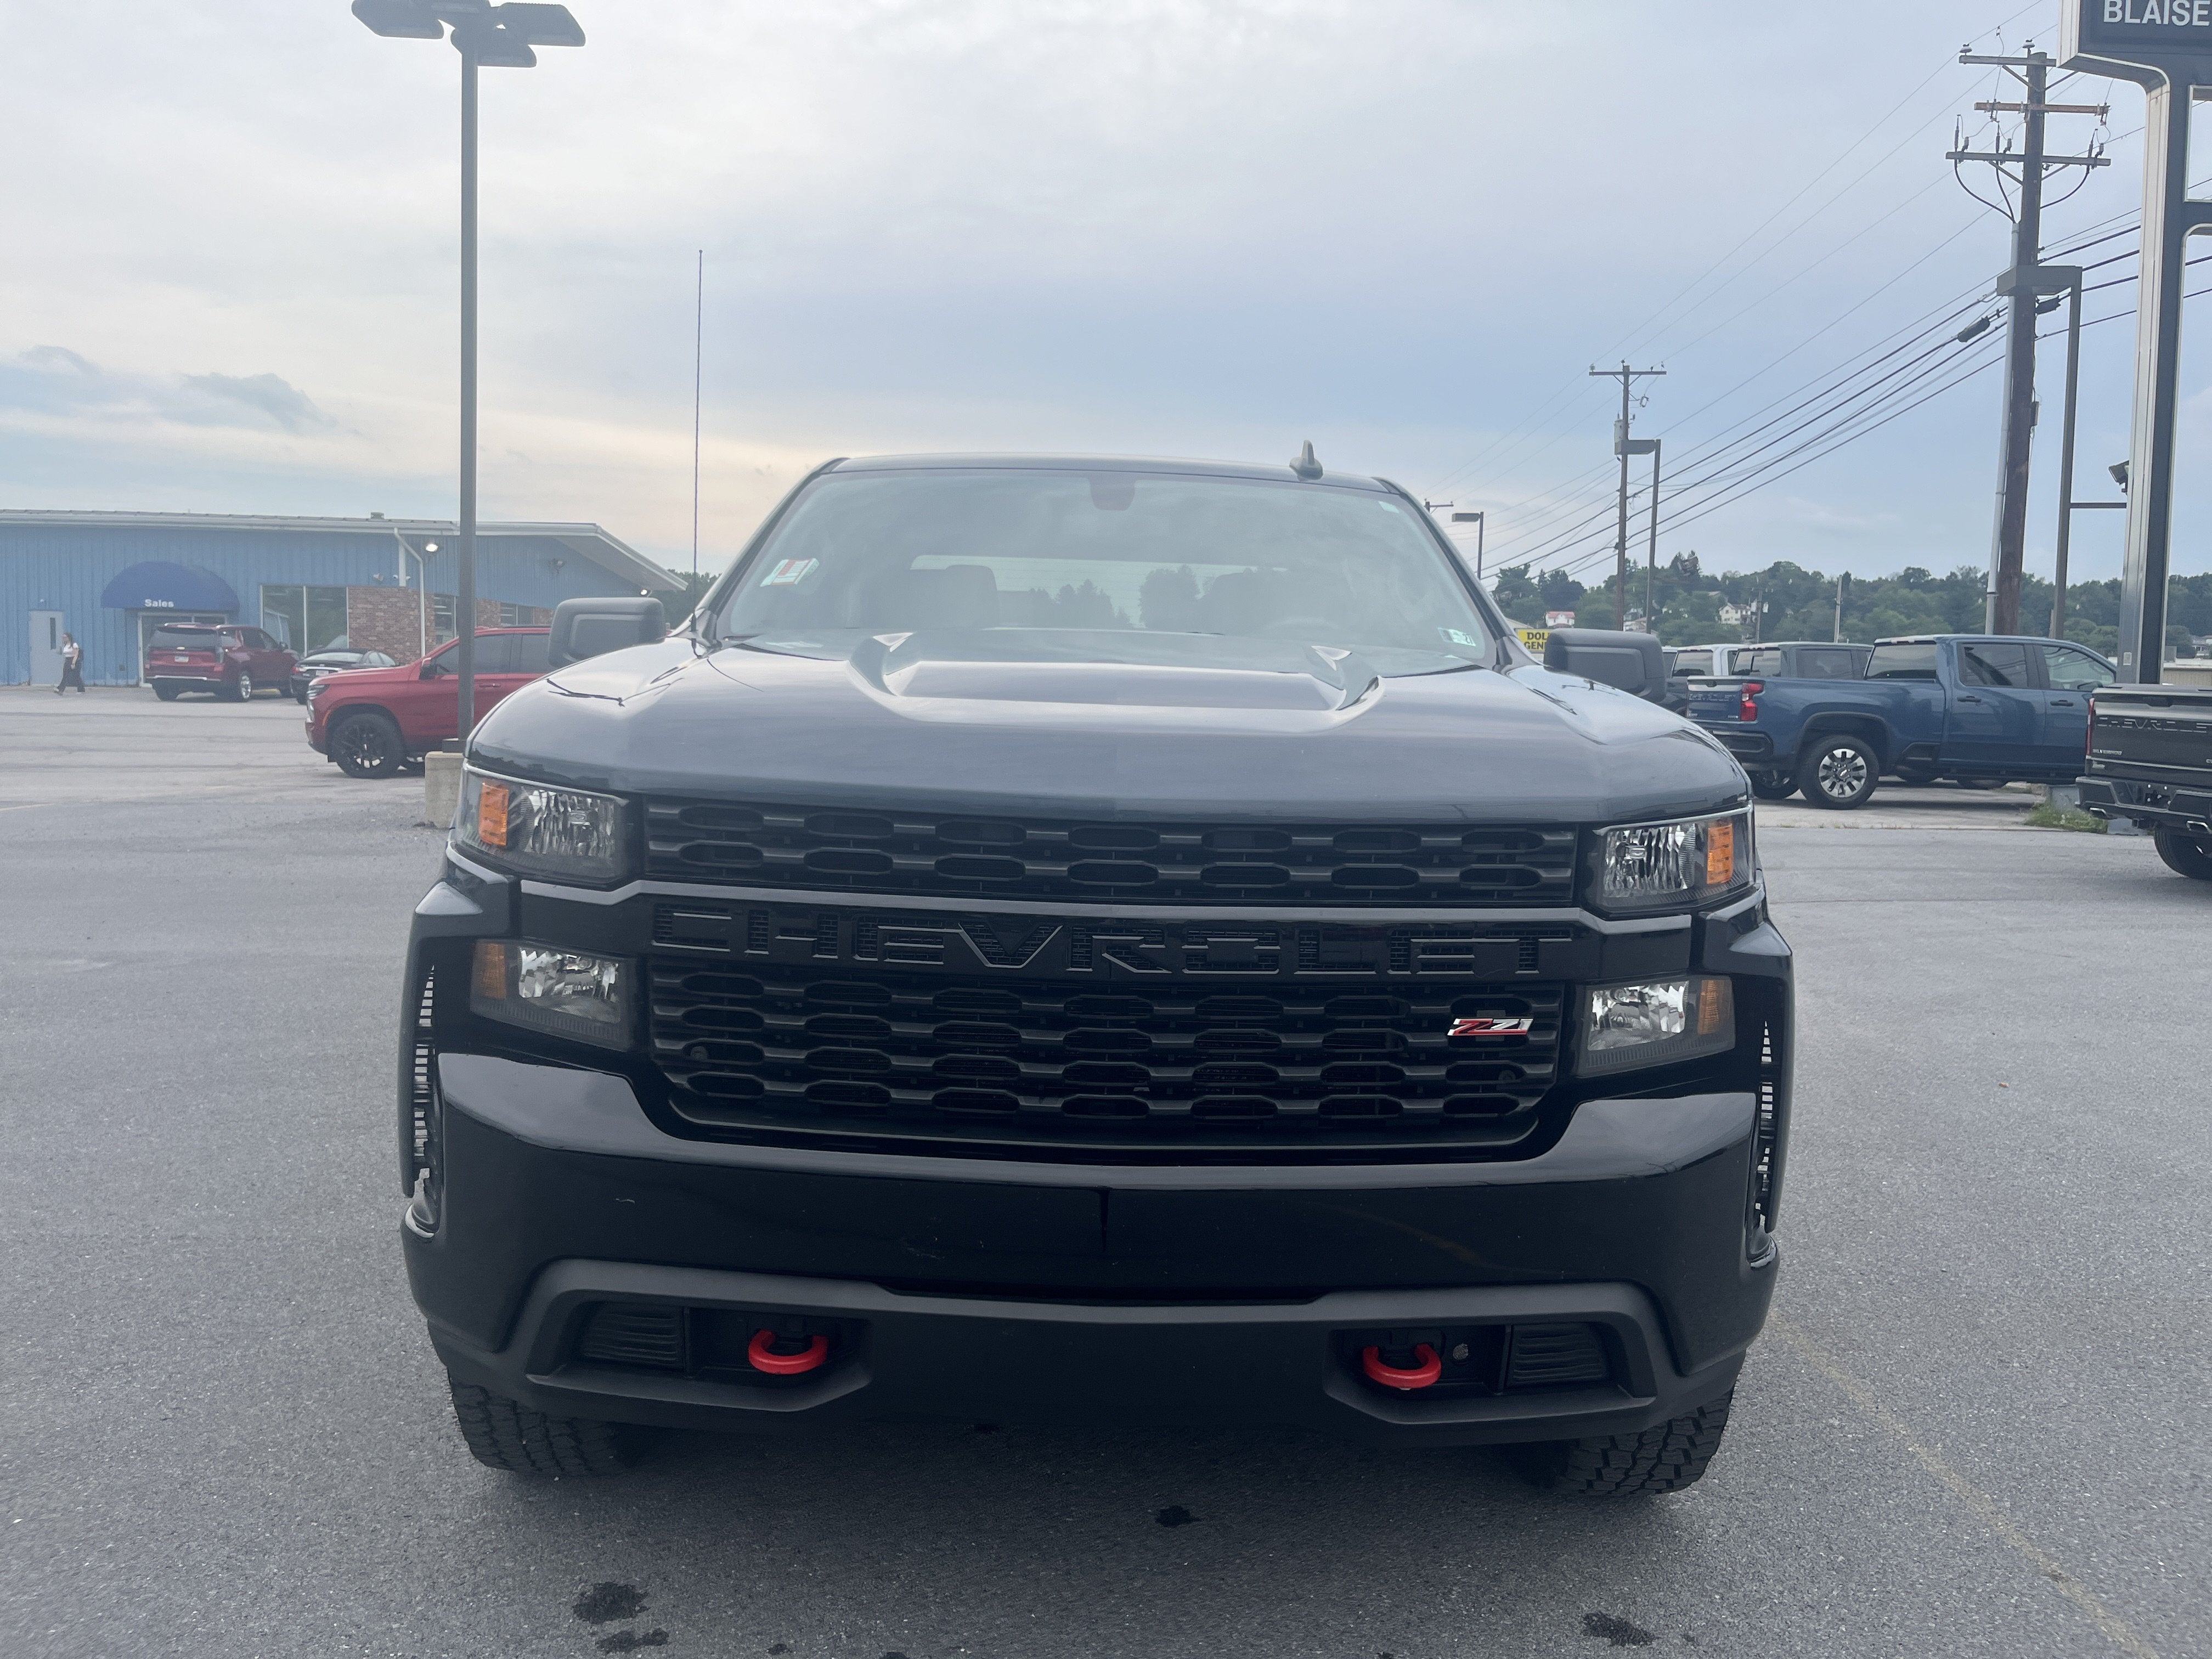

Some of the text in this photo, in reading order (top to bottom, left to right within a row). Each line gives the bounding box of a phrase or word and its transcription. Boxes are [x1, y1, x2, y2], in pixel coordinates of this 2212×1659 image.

[2103, 0, 2210, 26] BLAISE
[145, 599, 174, 607] Sales
[1527, 632, 1549, 640] DOL
[1524, 641, 1545, 650] GEN
[652, 902, 1572, 975] CHEVROLET
